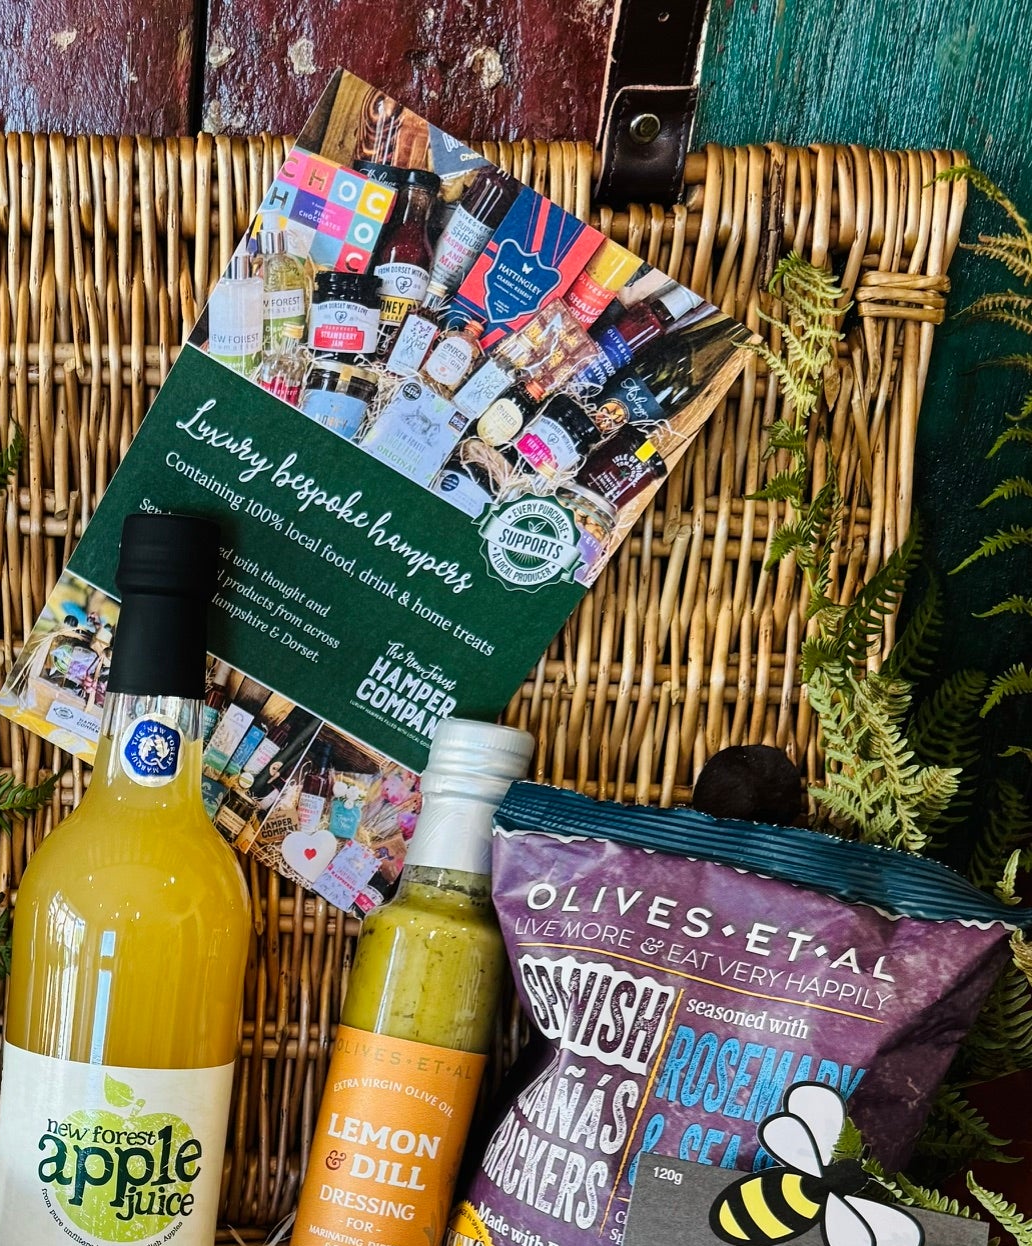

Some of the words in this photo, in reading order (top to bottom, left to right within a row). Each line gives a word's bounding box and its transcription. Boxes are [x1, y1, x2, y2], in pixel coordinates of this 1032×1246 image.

[499, 263, 542, 295] HATTINGLEY
[320, 330, 357, 340] STRAWBERRY
[176, 399, 273, 482] Luxury
[271, 452, 370, 528] bespoke
[367, 512, 473, 594] hampers
[512, 504, 537, 518] EVERY
[538, 504, 569, 533] PURCHASE
[165, 451, 245, 511] Containing
[245, 499, 284, 532] 100%
[284, 521, 320, 553] local
[320, 544, 358, 578] food,
[358, 568, 397, 599] drink
[398, 591, 410, 606] &
[412, 598, 453, 632] home
[453, 623, 495, 657] treats
[492, 552, 499, 560] A
[499, 528, 563, 559] SUPPORTS
[231, 552, 261, 575] with
[260, 568, 306, 607] thought
[306, 600, 331, 618] and
[494, 557, 516, 580] LOCAL
[511, 567, 552, 582] PRODUCER
[222, 575, 275, 611] products
[270, 604, 303, 628] from
[303, 625, 340, 649] across
[526, 883, 713, 940] OLIVES
[744, 921, 813, 962] ET
[829, 947, 896, 983] AL
[514, 917, 559, 936] LIVE
[558, 920, 635, 951] MORE
[640, 938, 664, 956] &
[667, 947, 715, 974] EAT
[714, 959, 786, 989] VERY
[784, 974, 892, 1011] HAPPILY
[686, 996, 768, 1031] seasoned
[769, 1015, 809, 1040] with
[46, 1118, 90, 1141] new
[92, 1125, 157, 1145] forest
[327, 1112, 441, 1160] LEMON
[38, 1125, 203, 1208] apple
[326, 1150, 346, 1170] &
[349, 1152, 426, 1191] DILL
[653, 1166, 684, 1186] 120g
[116, 1185, 195, 1220] juice
[319, 1184, 416, 1220] DRESSING
[163, 1221, 183, 1242] Apples
